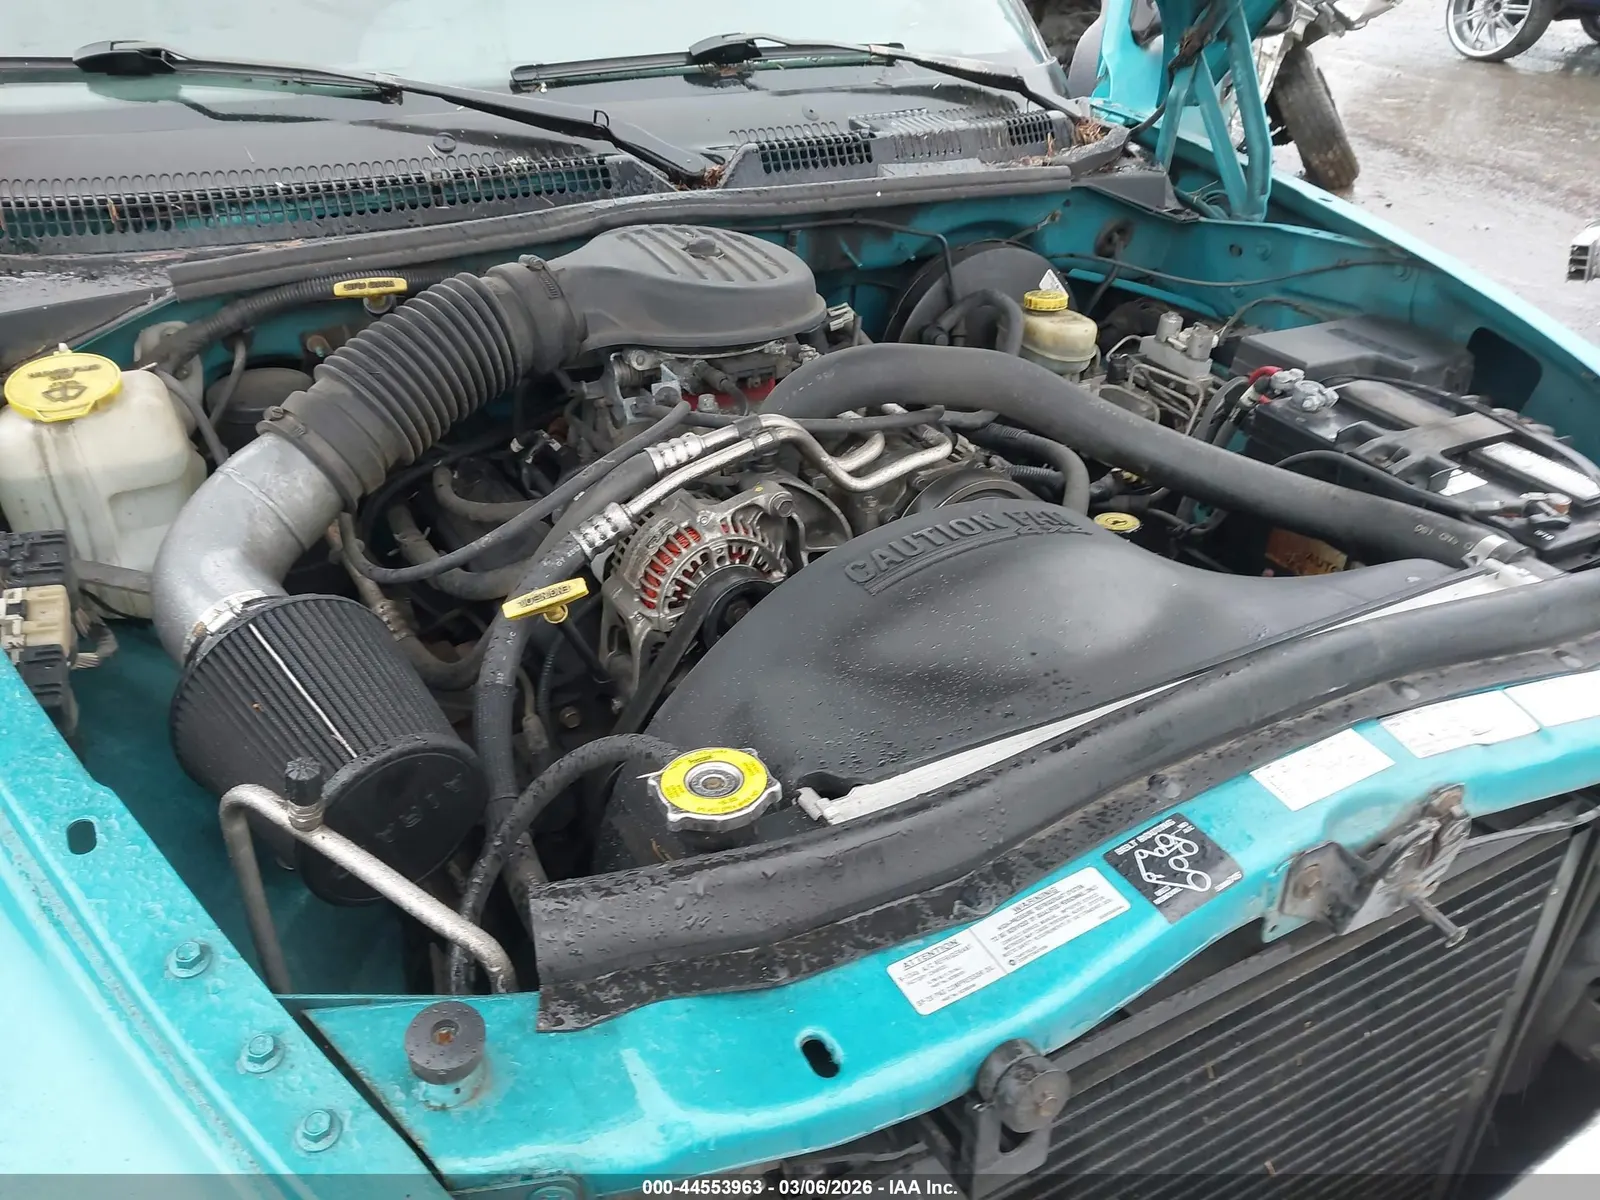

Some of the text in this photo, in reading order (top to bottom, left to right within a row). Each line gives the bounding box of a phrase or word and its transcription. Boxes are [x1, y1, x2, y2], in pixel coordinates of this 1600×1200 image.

[844, 511, 1079, 583] CAUTION FAN
[533, 585, 571, 603] ENGINE
[1010, 886, 1059, 912] WARNING
[901, 937, 959, 969] ATTENTION
